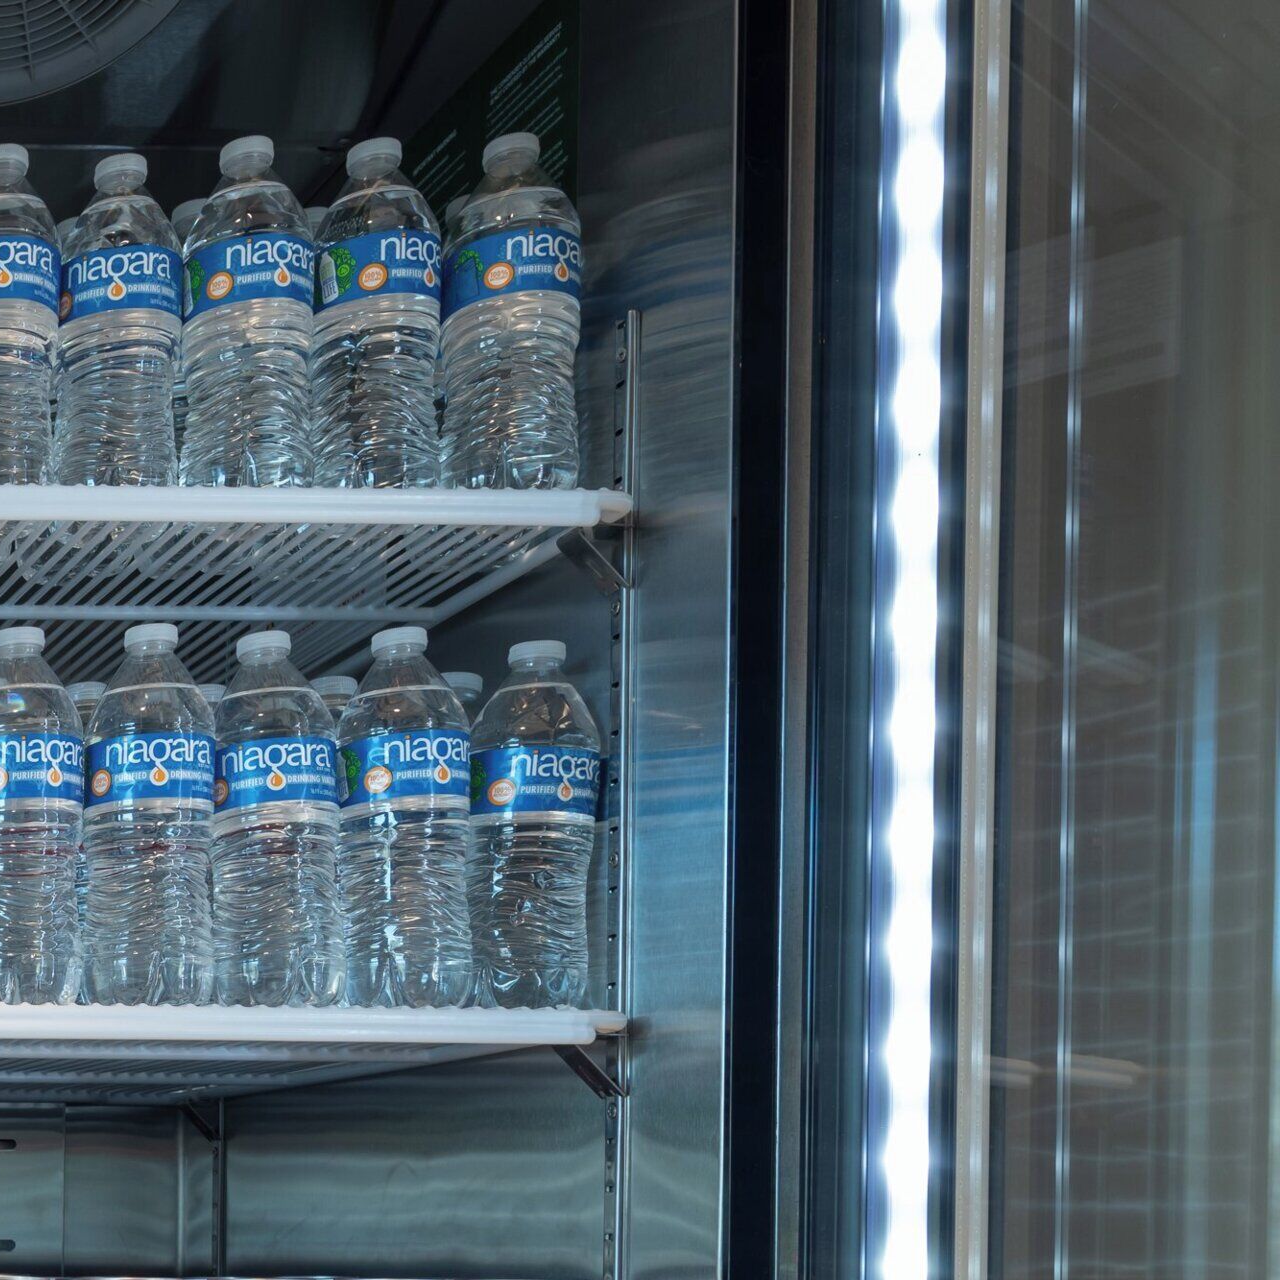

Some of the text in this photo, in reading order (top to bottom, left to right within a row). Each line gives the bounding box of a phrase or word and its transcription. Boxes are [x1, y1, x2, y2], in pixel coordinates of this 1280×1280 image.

[14, 273, 44, 284] DRINKING
[68, 251, 171, 288] niagara
[105, 737, 211, 769] niagara
[221, 743, 331, 776] niagara
[231, 775, 321, 789] PURIFIED DRINKING
